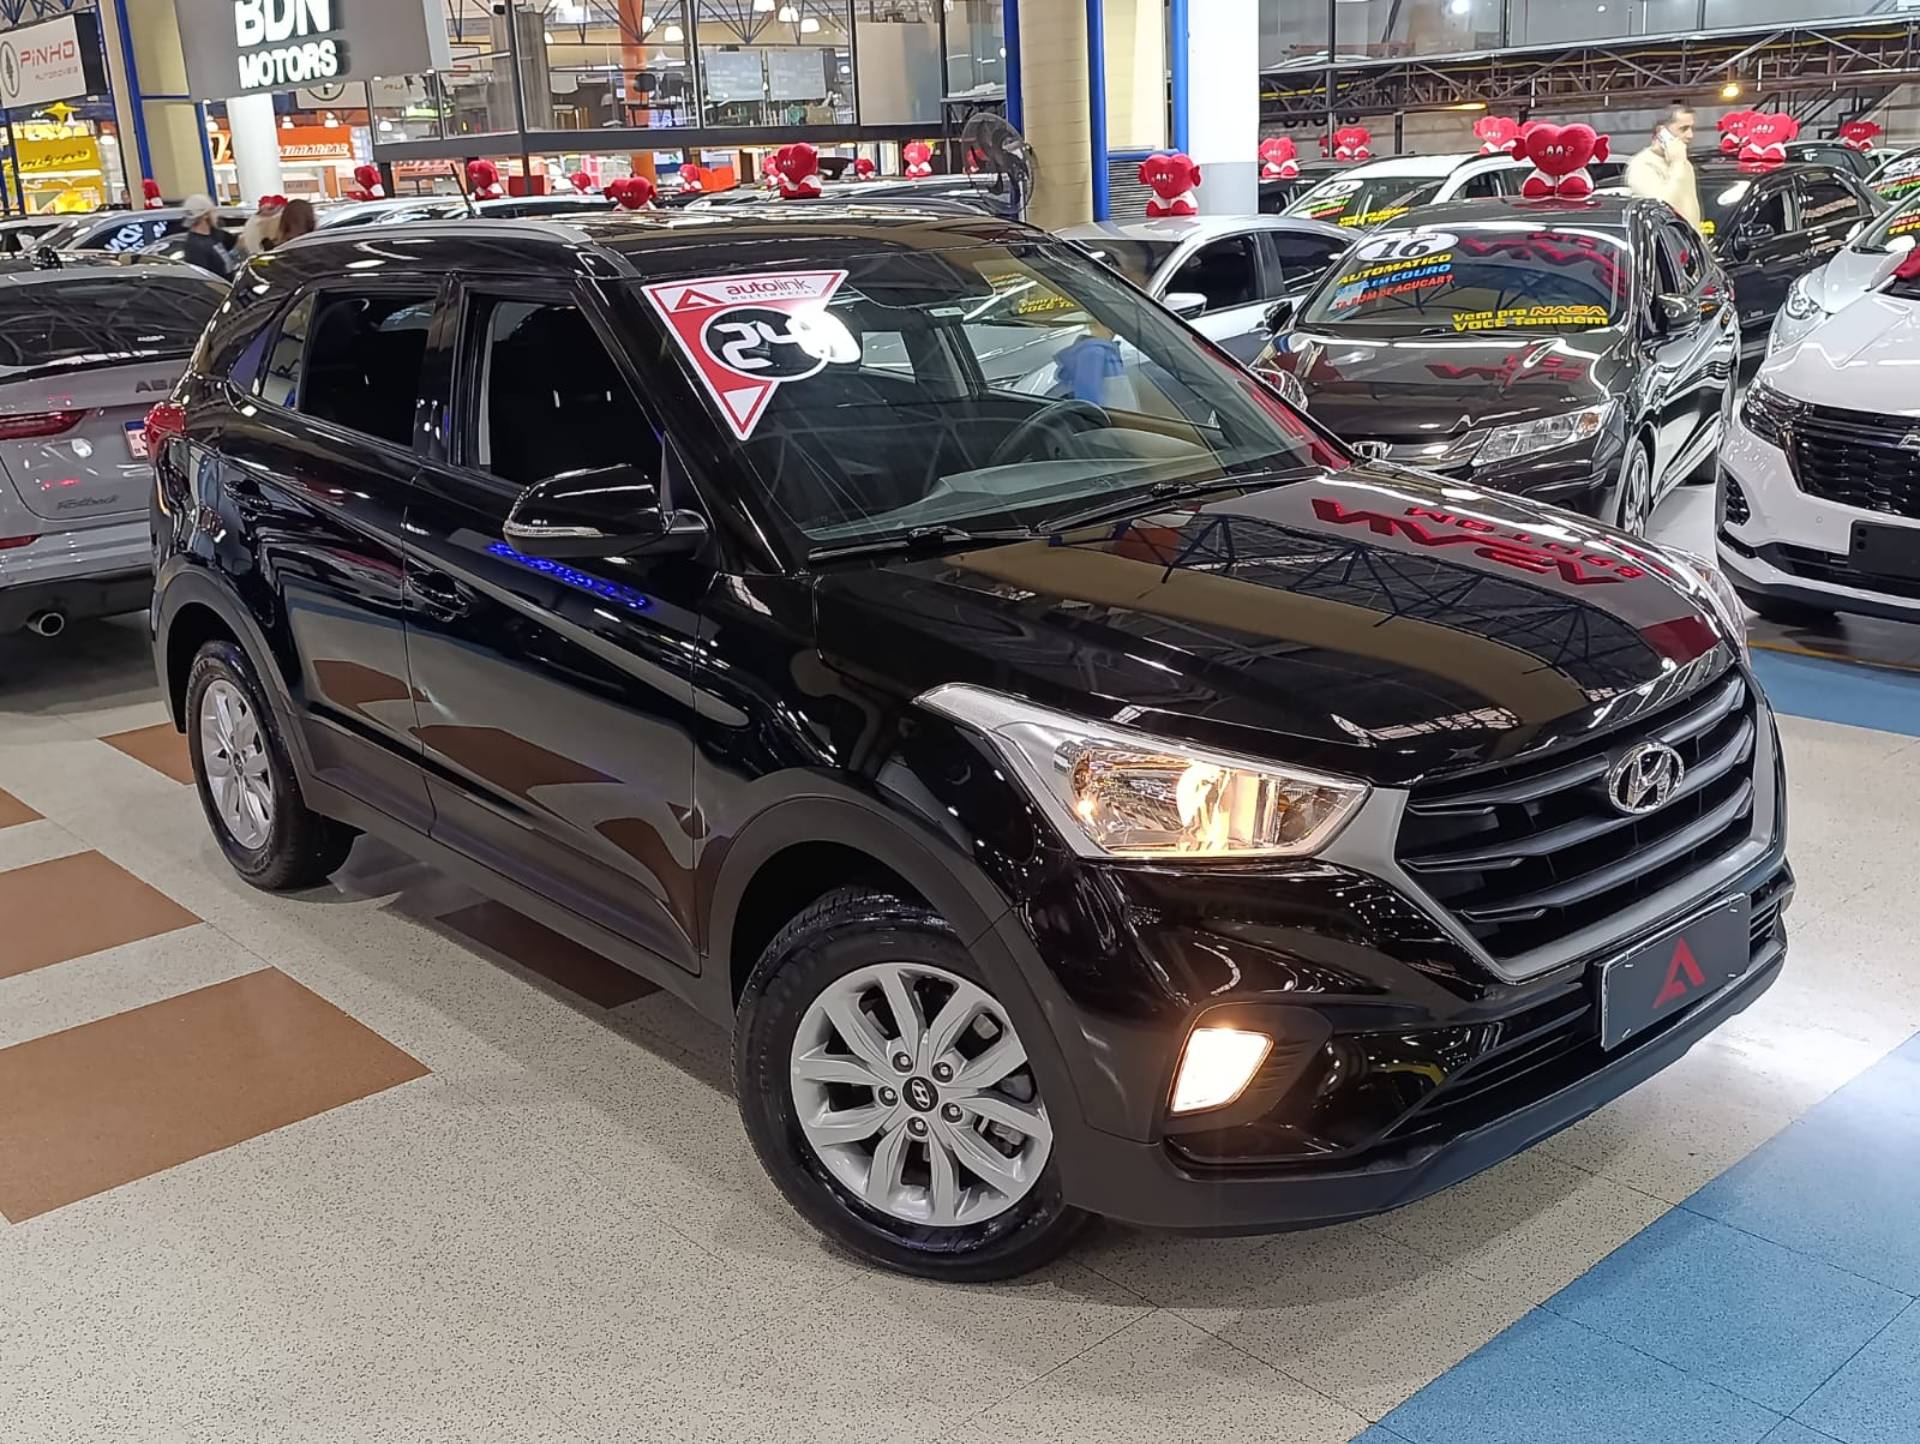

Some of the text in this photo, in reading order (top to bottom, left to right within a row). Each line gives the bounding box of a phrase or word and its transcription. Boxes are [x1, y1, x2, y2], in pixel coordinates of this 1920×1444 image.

[235, 0, 330, 47] BDN
[20, 40, 75, 68] PINHO
[238, 39, 338, 89] MOTORS
[1373, 238, 1438, 259] 16
[1391, 263, 1452, 282] COURO
[725, 278, 812, 291] autolink
[1453, 312, 1493, 321] Vem
[1530, 305, 1608, 316] NASA
